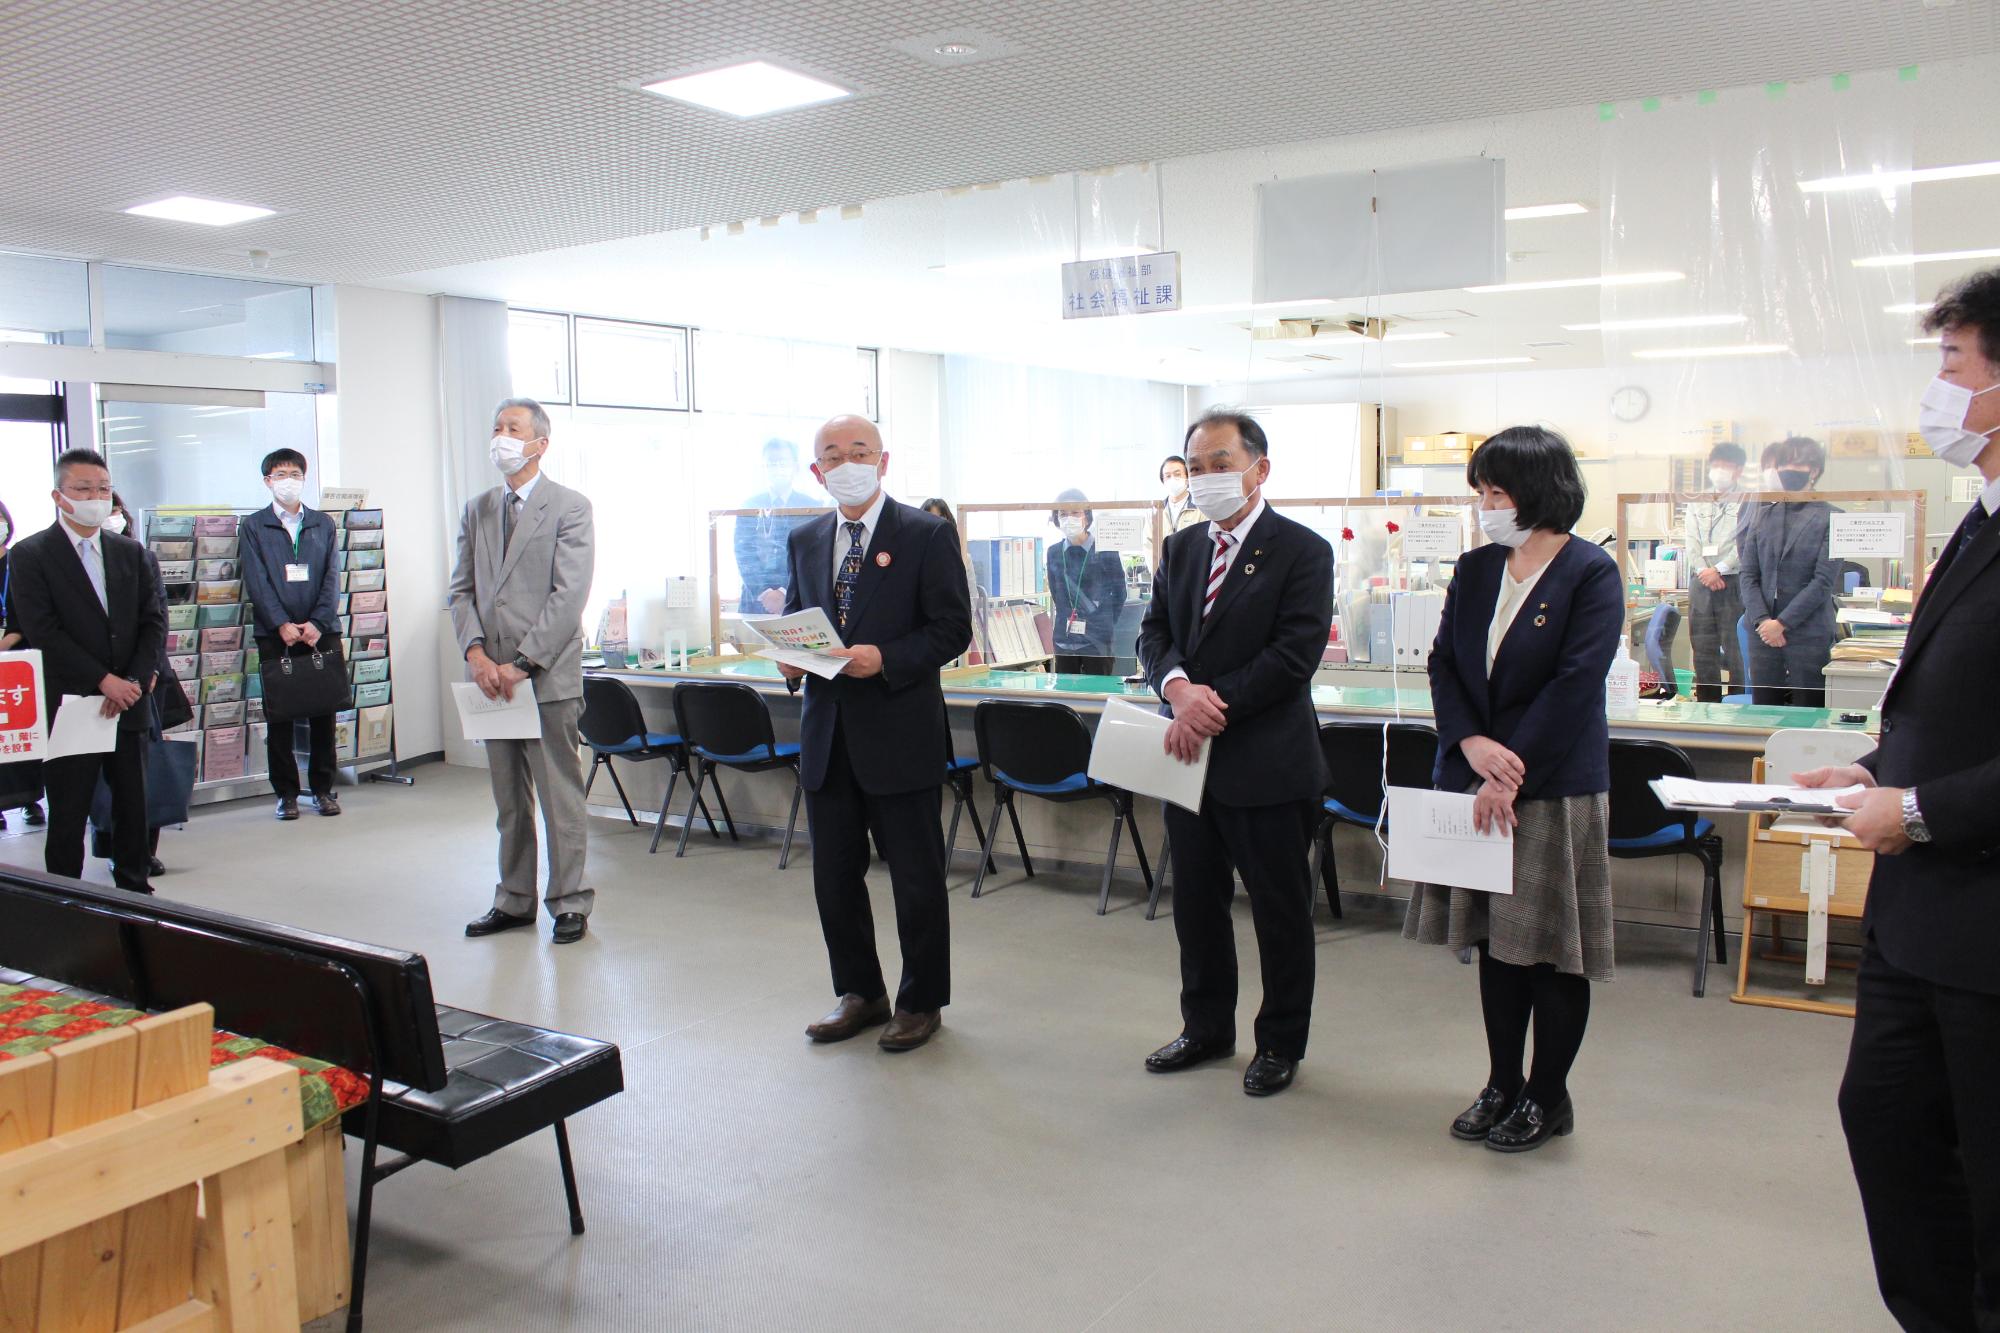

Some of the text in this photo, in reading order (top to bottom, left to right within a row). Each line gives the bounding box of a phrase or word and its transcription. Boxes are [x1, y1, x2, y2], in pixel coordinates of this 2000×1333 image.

[1069, 284, 1173, 311] 社会福祉課
